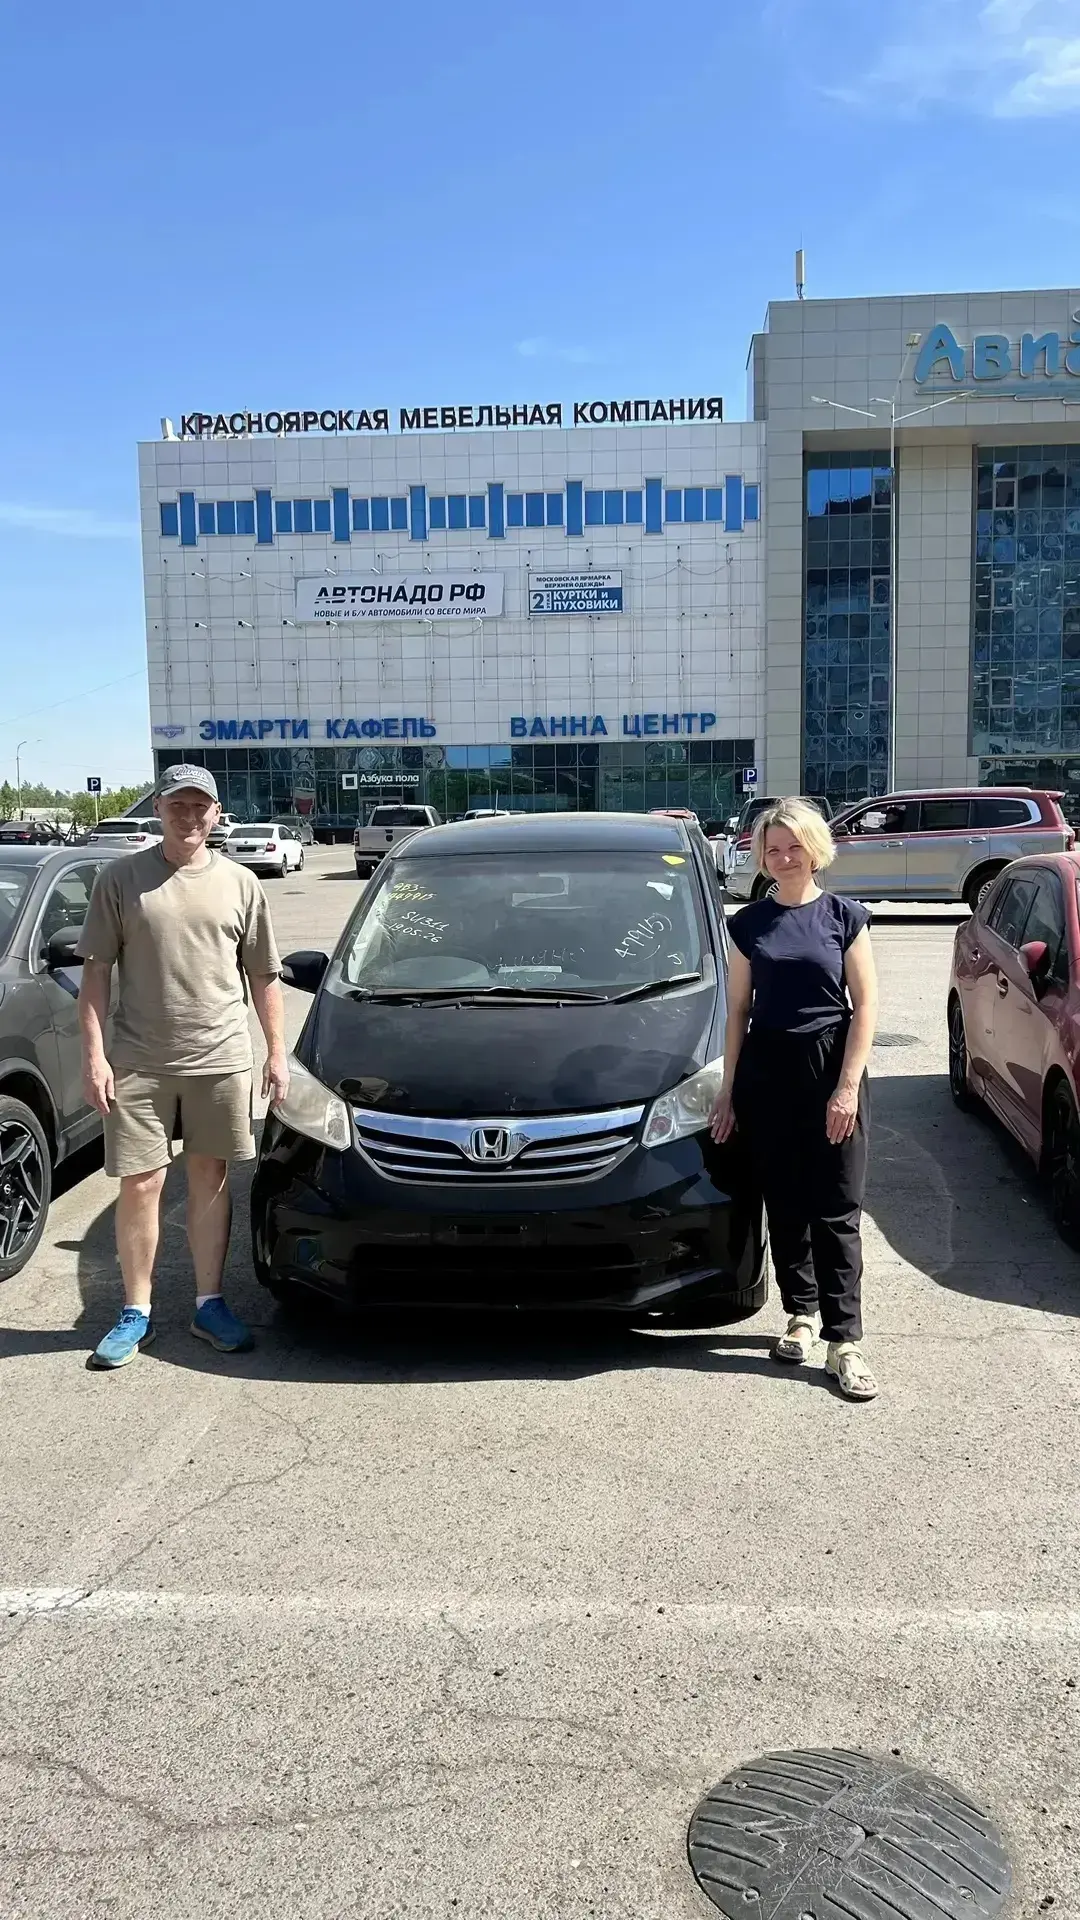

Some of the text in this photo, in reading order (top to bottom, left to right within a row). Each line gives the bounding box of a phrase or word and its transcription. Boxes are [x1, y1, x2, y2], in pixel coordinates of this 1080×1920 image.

[181, 397, 723, 435] КРАСНОЯРСКАЯ МЕБЕЛЬНАЯ КОМПАНИЯ
[314, 583, 486, 605] АВТОНАДО РФ
[553, 590, 598, 600] КУРТКИ
[532, 593, 545, 609] 2
[553, 600, 618, 610] ПУХОВИКИ
[314, 610, 342, 618] НОВЫЕ
[367, 608, 423, 617] АВТОМОБИЛИ
[424, 608, 435, 616] СО
[436, 607, 461, 616] ВСЕГО
[463, 607, 487, 615] МИРА
[199, 717, 437, 741] ЭМАРТИ КАФЕЛЬ
[510, 712, 717, 738] ВАННА ЦЕНТР
[360, 774, 393, 784] Азбука
[746, 769, 756, 782] P
[90, 778, 99, 790] P
